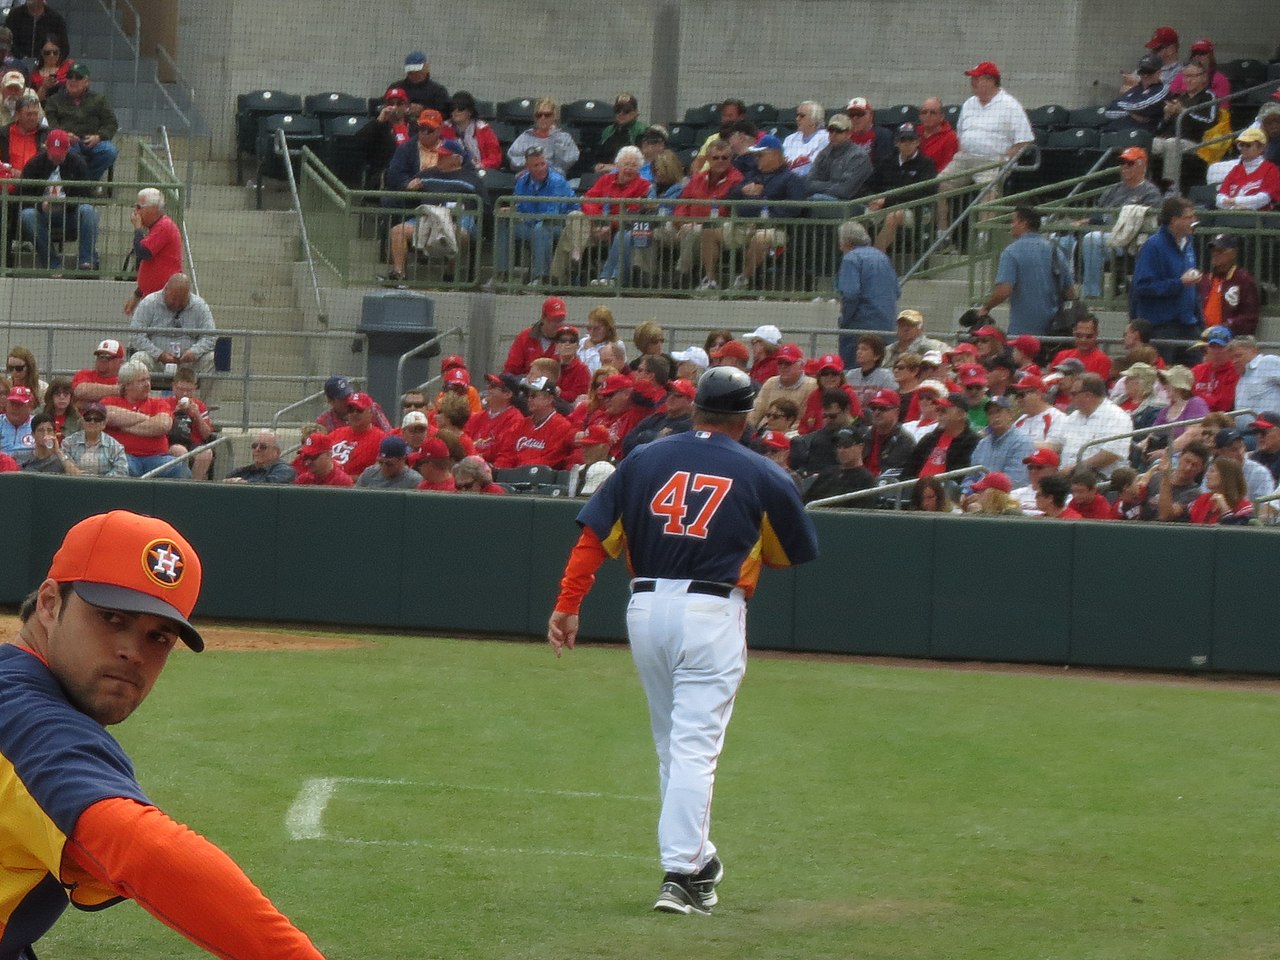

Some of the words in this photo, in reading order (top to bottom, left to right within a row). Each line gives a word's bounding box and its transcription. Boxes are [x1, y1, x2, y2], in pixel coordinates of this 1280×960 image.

[632, 222, 650, 231] 212
[650, 470, 734, 539] 47
[153, 548, 180, 578] H
